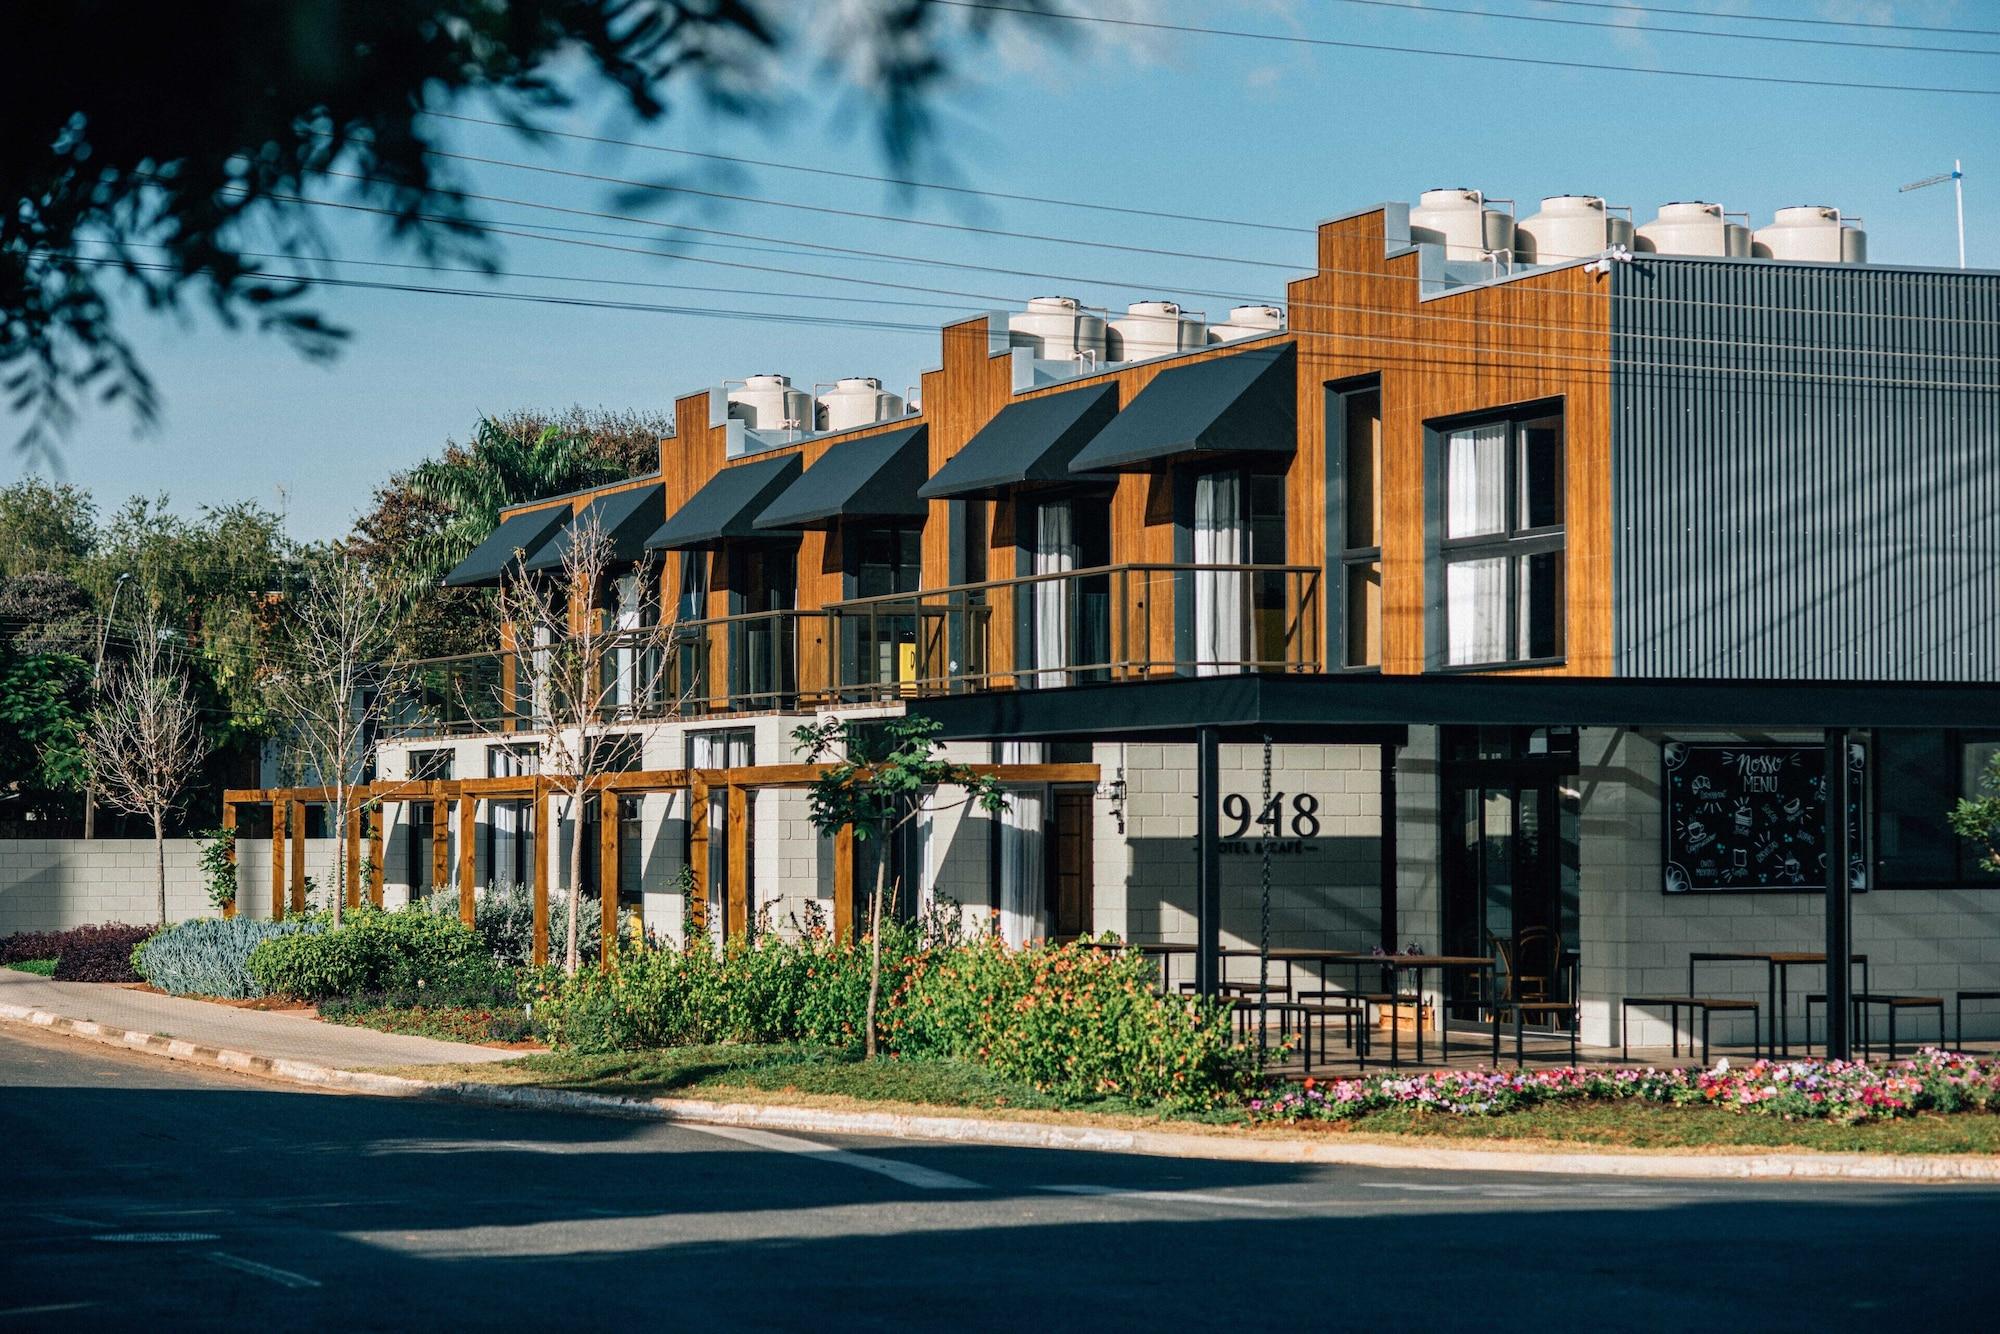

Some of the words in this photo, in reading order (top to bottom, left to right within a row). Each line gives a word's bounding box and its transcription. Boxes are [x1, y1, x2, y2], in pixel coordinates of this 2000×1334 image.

[1743, 775, 1778, 792] MENU
[1193, 791, 1320, 839] 948
[1217, 841, 1250, 854] OTEL
